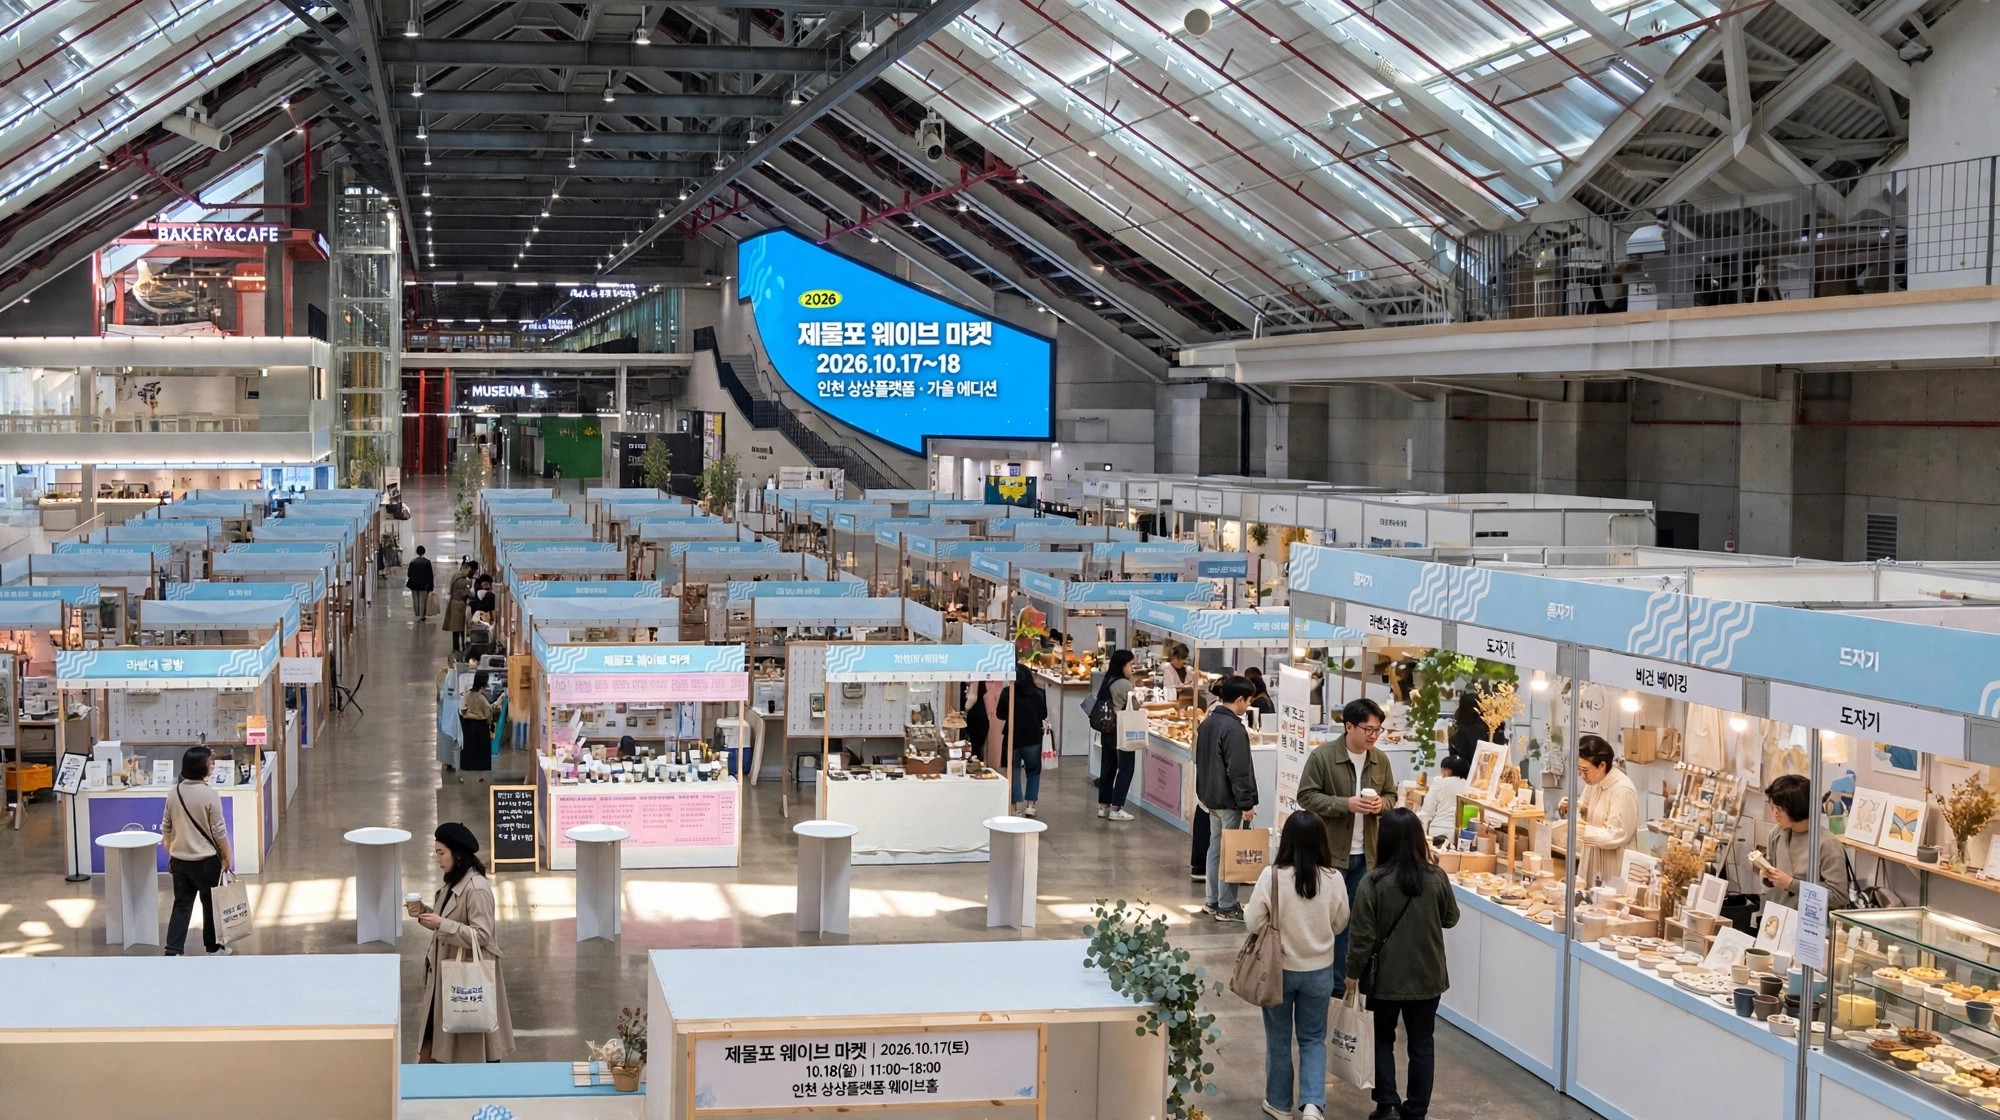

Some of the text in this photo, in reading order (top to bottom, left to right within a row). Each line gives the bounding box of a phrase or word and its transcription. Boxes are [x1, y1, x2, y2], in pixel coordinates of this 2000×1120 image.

[157, 226, 279, 242] BAKERY&CAFE
[805, 293, 837, 306] 2026
[798, 321, 992, 346] 제물포 웨이브 마켓
[816, 353, 961, 374] 2026.10.17~18
[472, 385, 525, 397] MUSEUM
[817, 380, 845, 397] 인천
[848, 380, 915, 397] 상상플랫폼
[927, 380, 954, 397] 가을
[957, 380, 998, 397] 에디션
[1636, 668, 1688, 693] 비건 베이킹
[1840, 706, 1880, 733] 도자기
[725, 1045, 776, 1064] 제물포
[780, 1043, 831, 1062] 웨이브
[834, 1041, 867, 1060] 마켓
[880, 1040, 970, 1056] 2026.10.17(토)
[869, 1061, 942, 1076] 11:00~18:00
[792, 1082, 818, 1098] 인천
[888, 1077, 940, 1095] 웨이브홀
